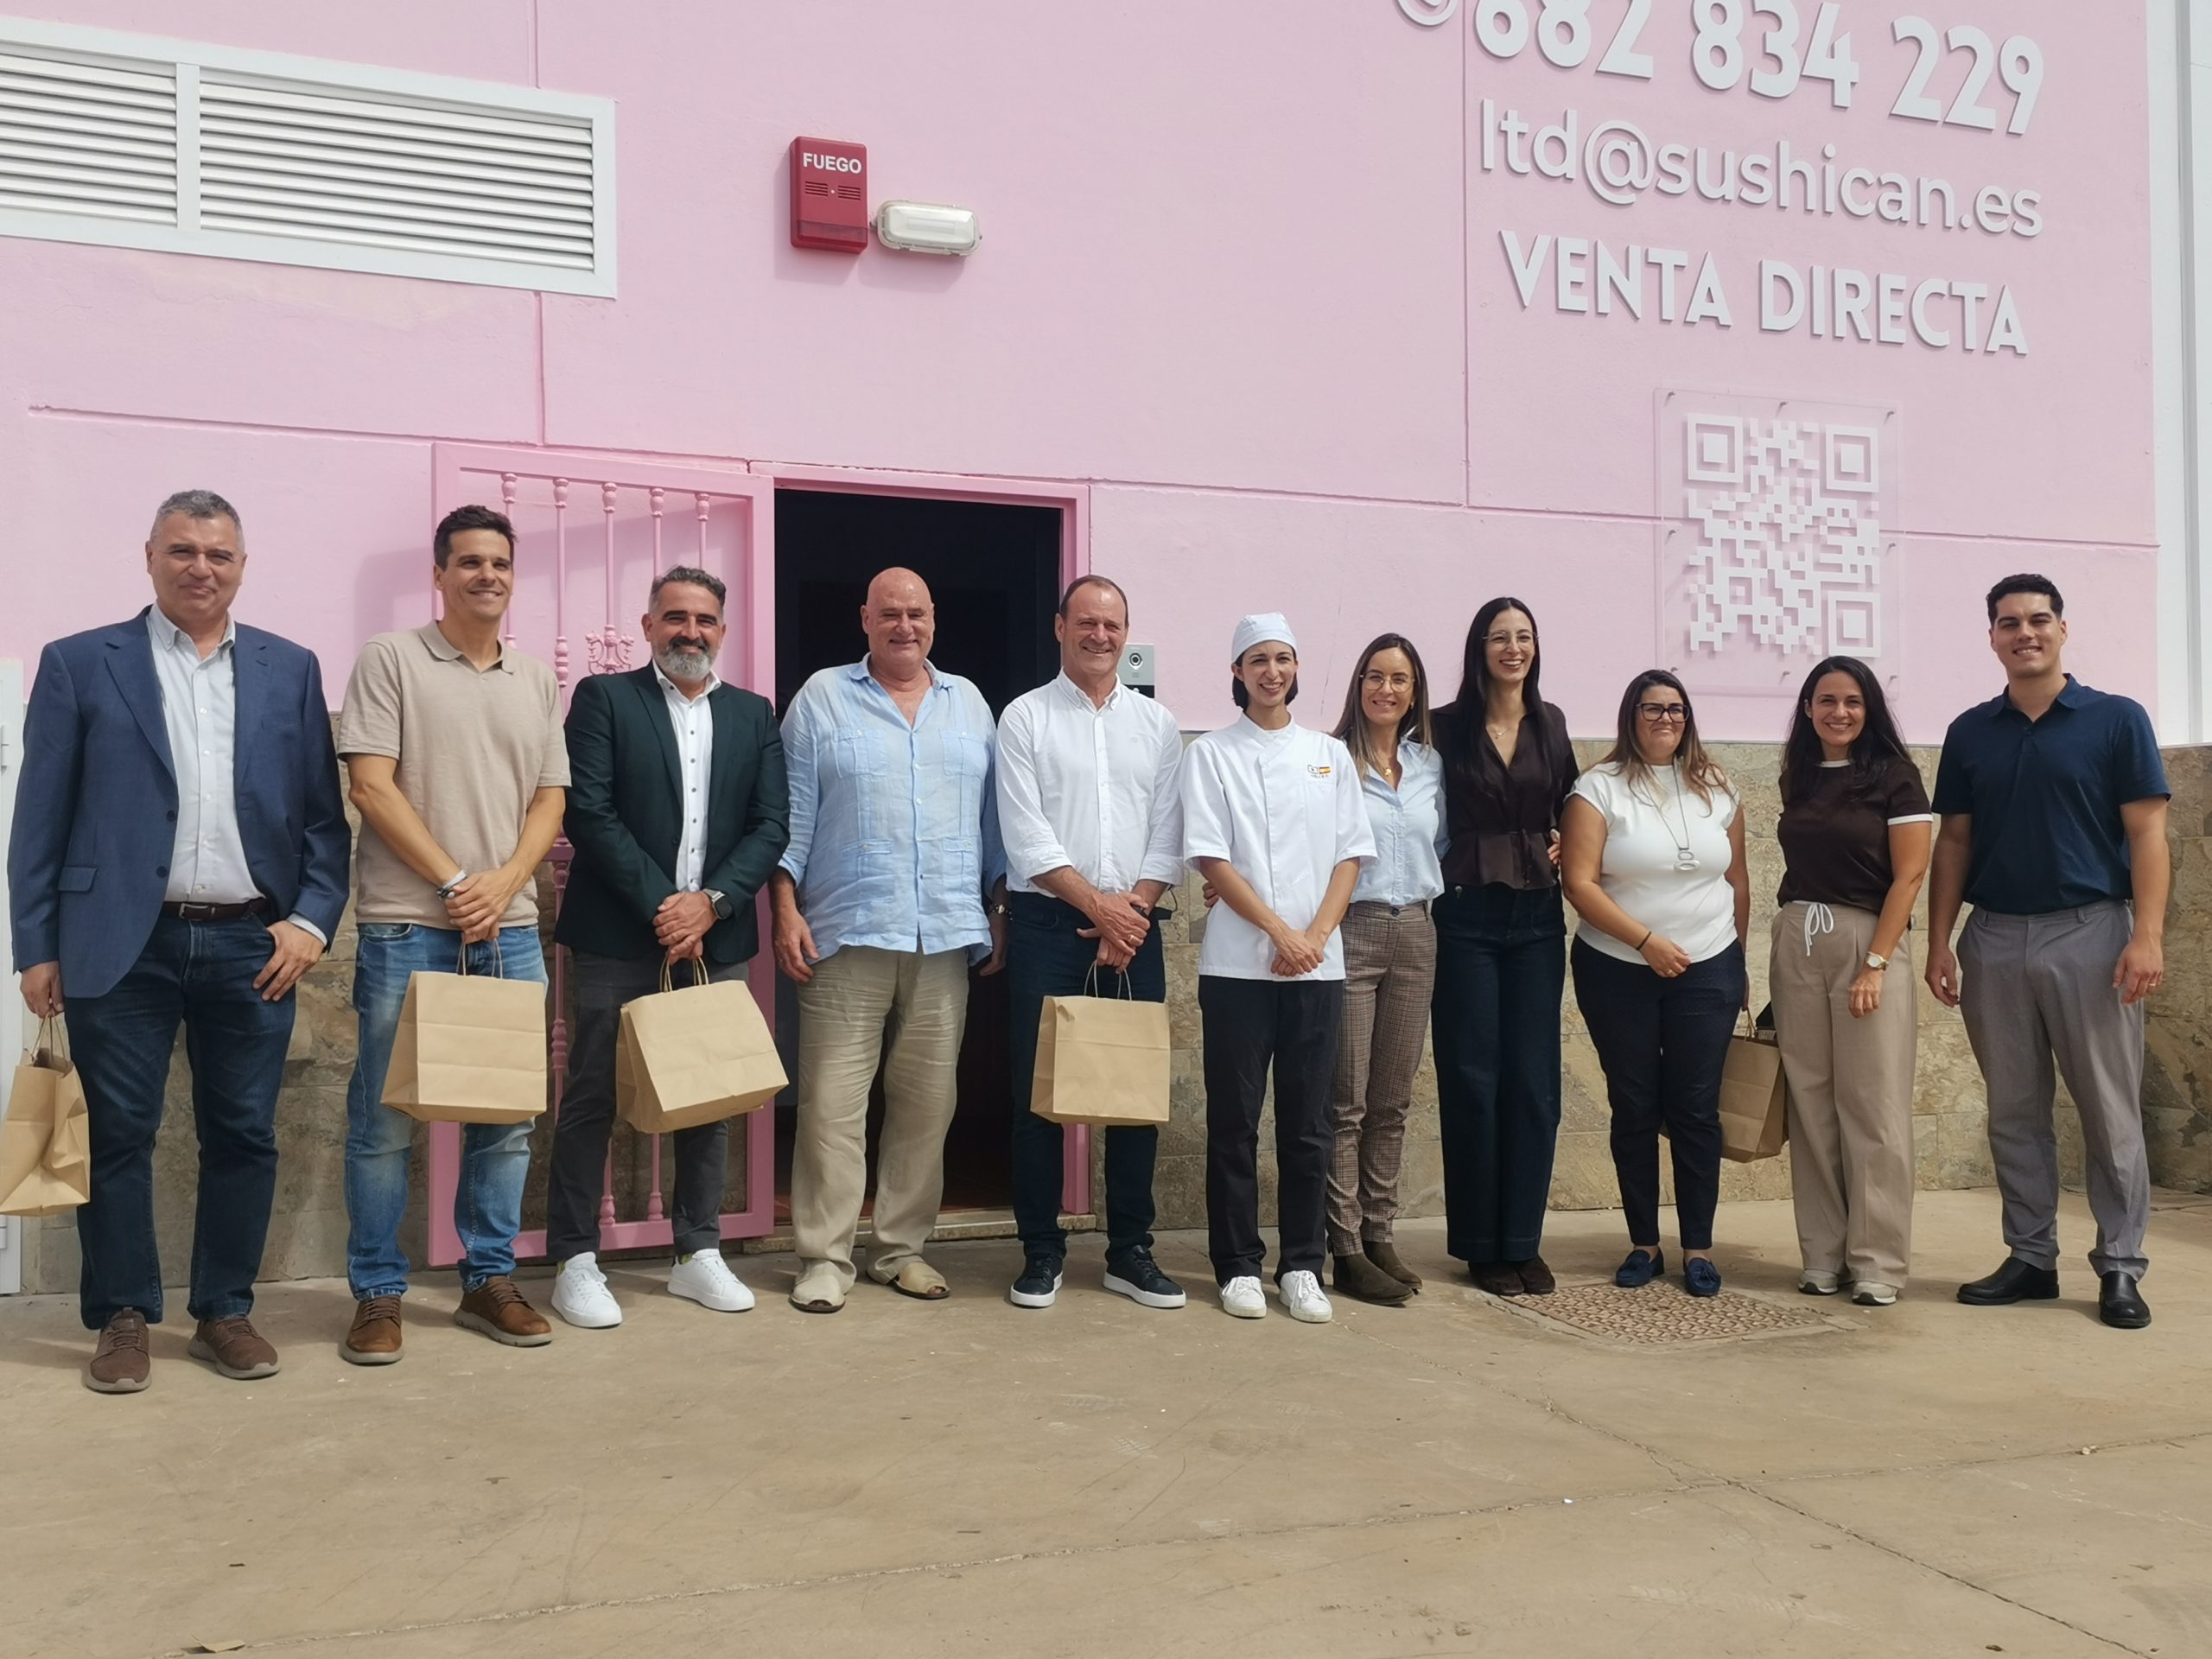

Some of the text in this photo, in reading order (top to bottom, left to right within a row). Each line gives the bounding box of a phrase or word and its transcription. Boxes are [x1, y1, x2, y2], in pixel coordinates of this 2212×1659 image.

[1691, 0, 1859, 108] 834
[1890, 16, 2044, 135] 229
[803, 152, 861, 174] FUEGO
[1481, 99, 2043, 237] ltd@sushican.es
[1500, 230, 2029, 354] VENTA DIRECTA
